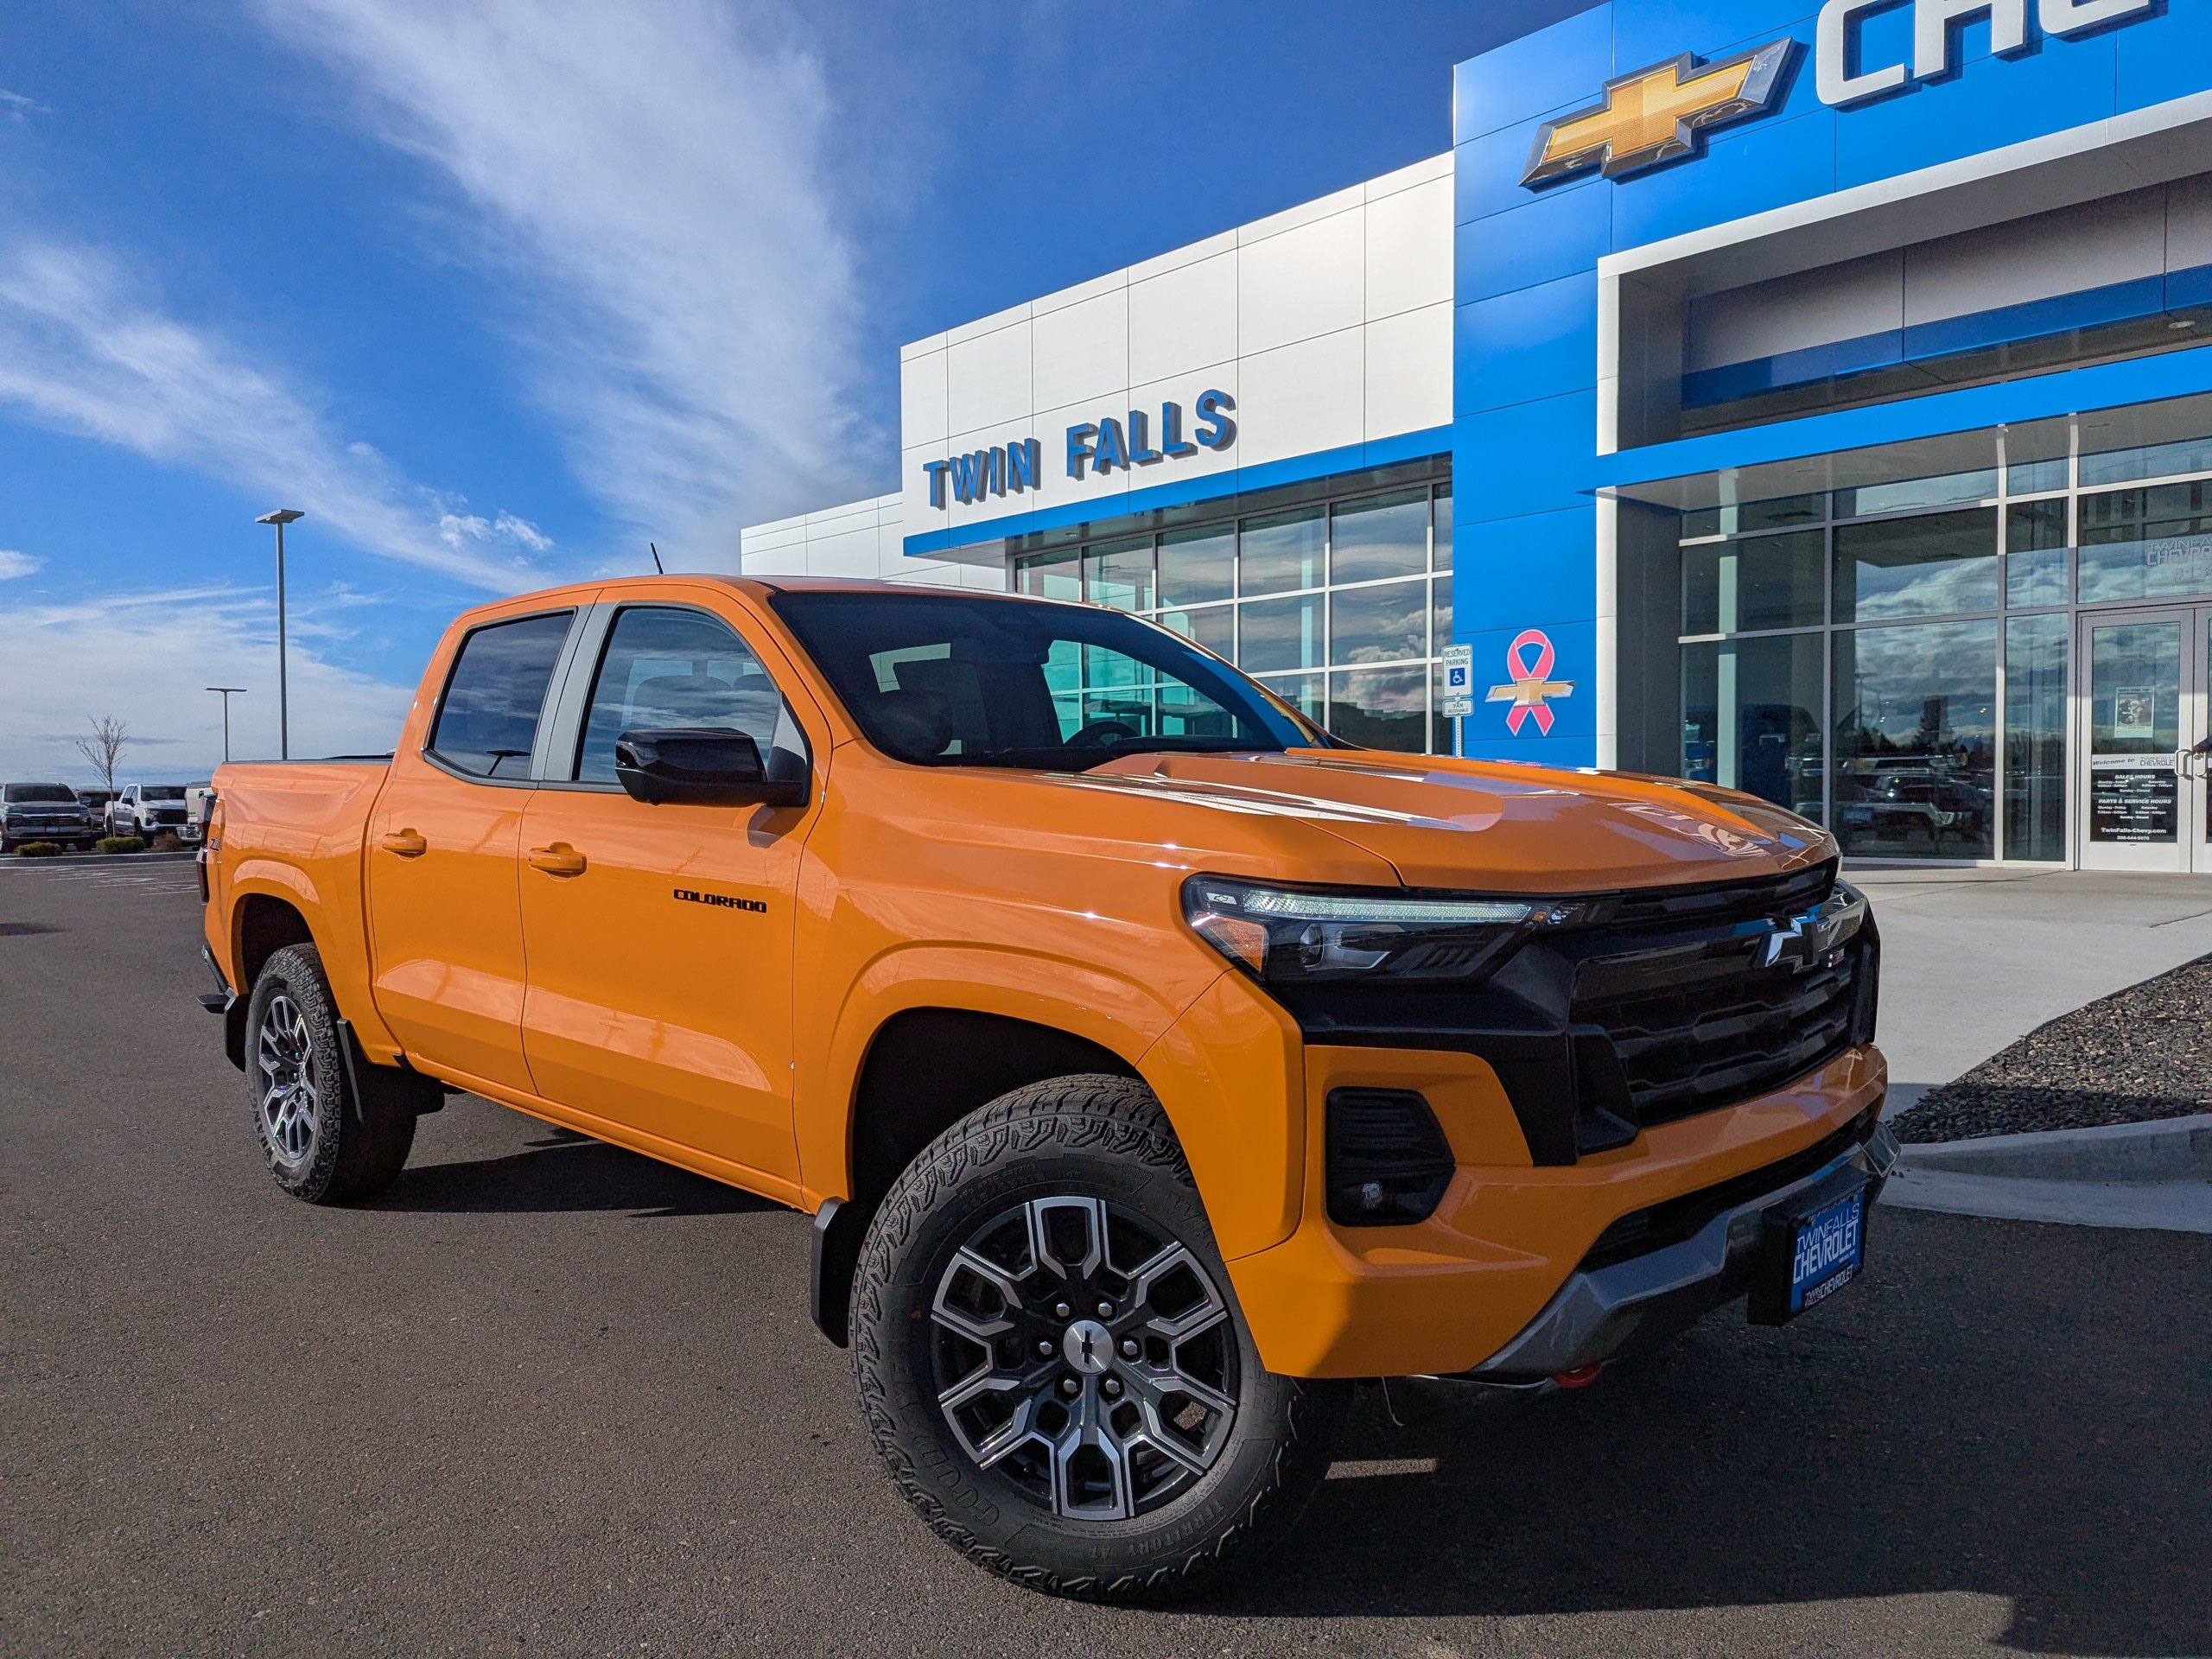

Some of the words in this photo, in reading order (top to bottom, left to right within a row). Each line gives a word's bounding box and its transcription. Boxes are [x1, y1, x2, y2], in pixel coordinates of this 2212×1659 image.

[1816, 0, 2152, 105] CH
[923, 437, 1042, 511] TWIN
[1066, 388, 1238, 481] FALLS
[1444, 649, 1471, 658] RESERVED
[1446, 658, 1469, 667] PARKING
[673, 888, 768, 914] COLORADO
[1793, 1217, 1859, 1285] CHEVROLET
[1820, 1264, 1854, 1299] CHEVROLET
